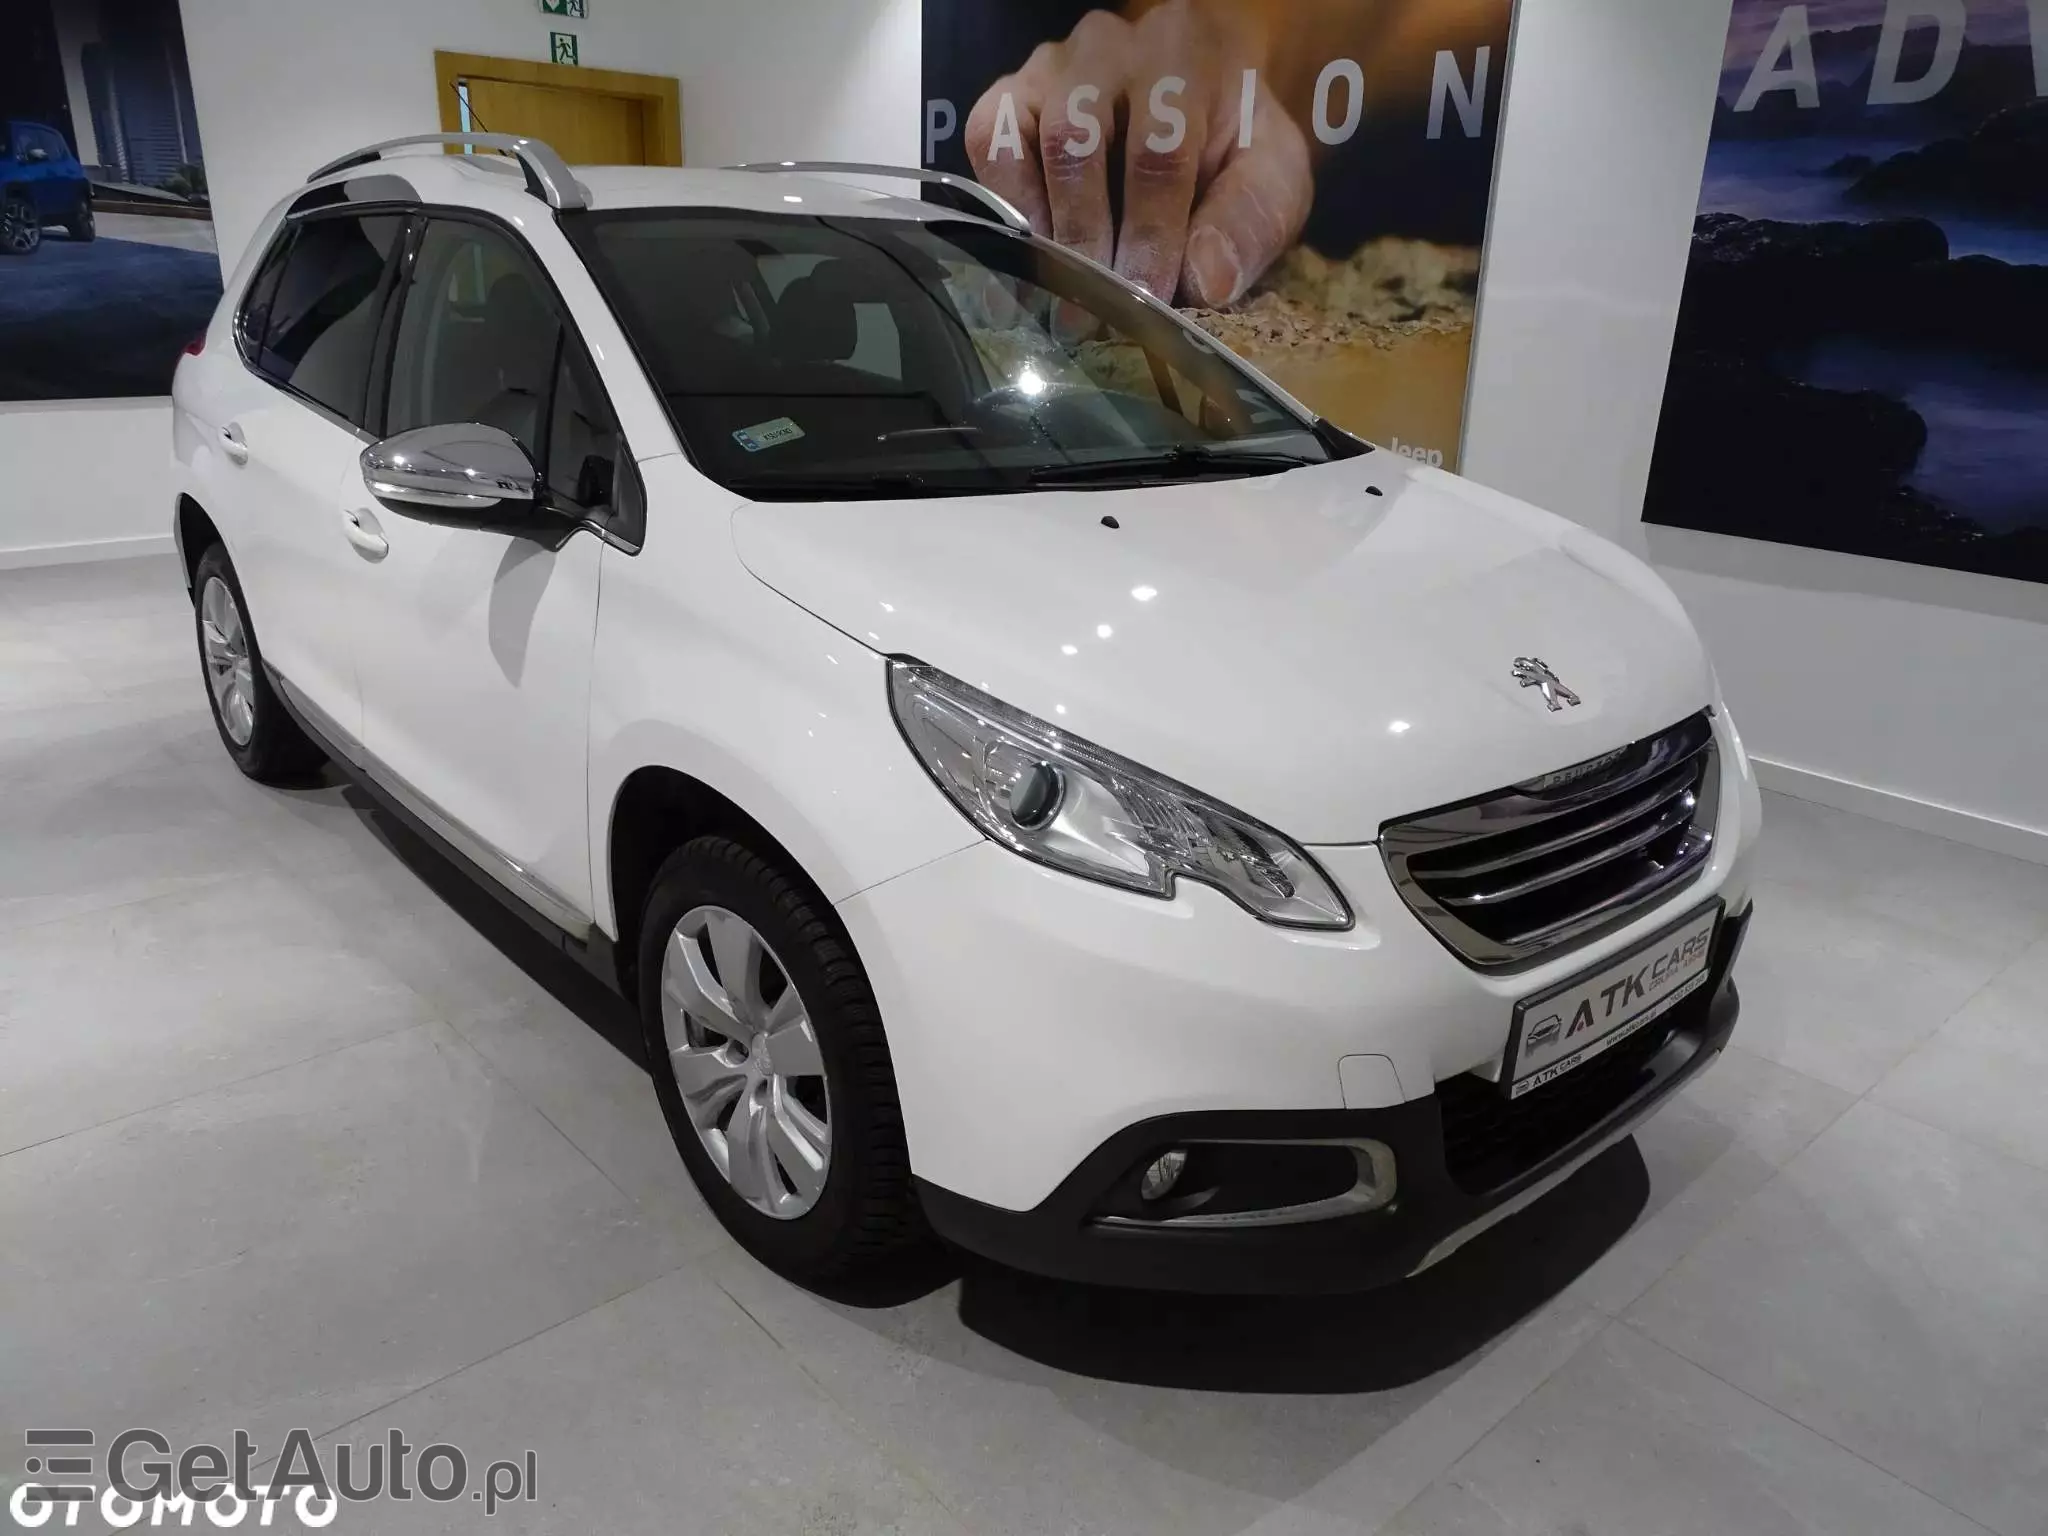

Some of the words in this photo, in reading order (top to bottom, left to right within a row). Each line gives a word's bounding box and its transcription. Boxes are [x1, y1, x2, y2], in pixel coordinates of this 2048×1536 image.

[925, 45, 1490, 164] PASSION
[1733, 0, 2048, 112] AD
[1565, 964, 1650, 1039] ATK
[1652, 927, 1710, 979] CARS
[1532, 1066, 1558, 1088] ATK
